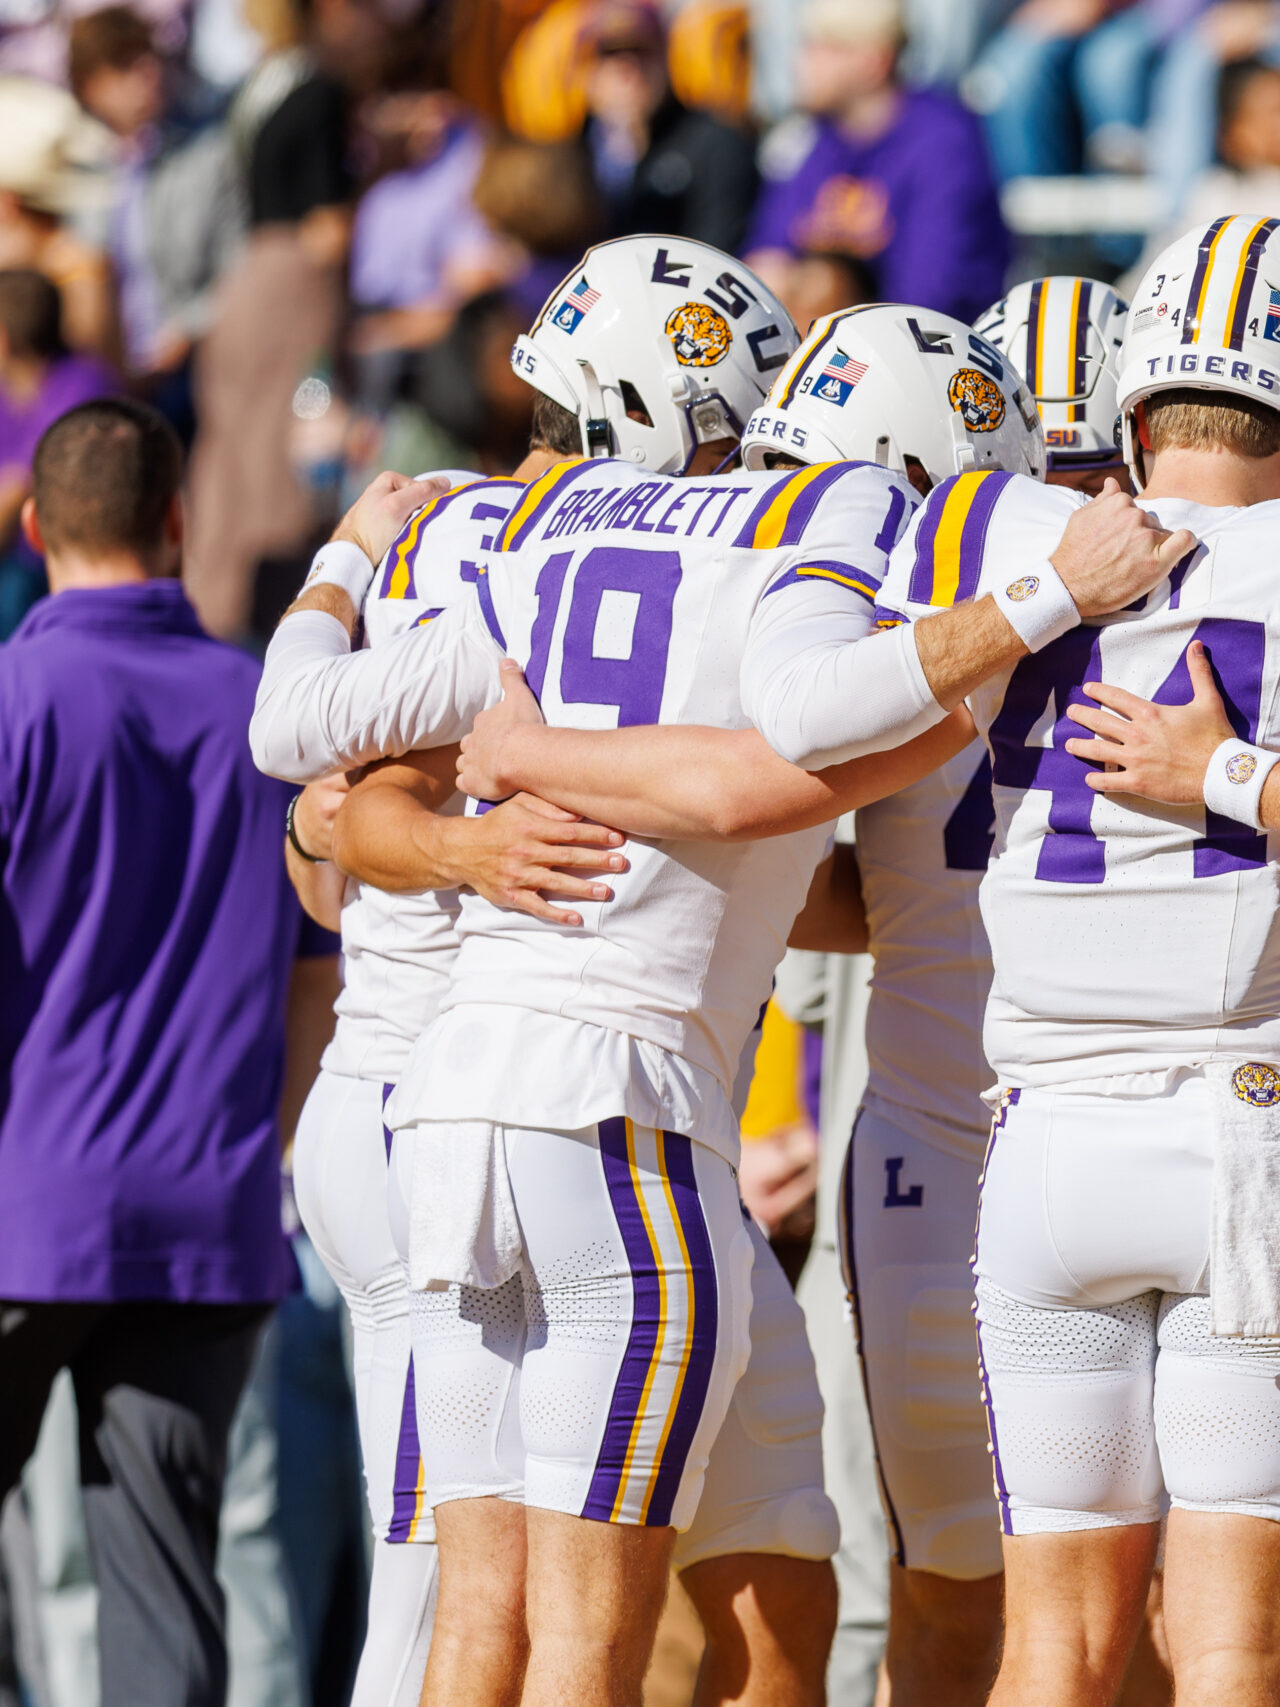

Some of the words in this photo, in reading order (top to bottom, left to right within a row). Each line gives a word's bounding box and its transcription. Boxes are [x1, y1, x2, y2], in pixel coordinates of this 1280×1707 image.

[1152, 274, 1166, 297] 3
[651, 248, 790, 373] LSU
[1171, 308, 1181, 326] 4
[1248, 317, 1259, 337] 4
[799, 376, 813, 394] 9
[1147, 354, 1277, 391] TIGERS
[742, 417, 807, 448] GERS
[1046, 429, 1077, 446] SU
[541, 481, 752, 541] BRAMBLETT
[505, 547, 682, 745] 19
[988, 617, 1268, 884] 44
